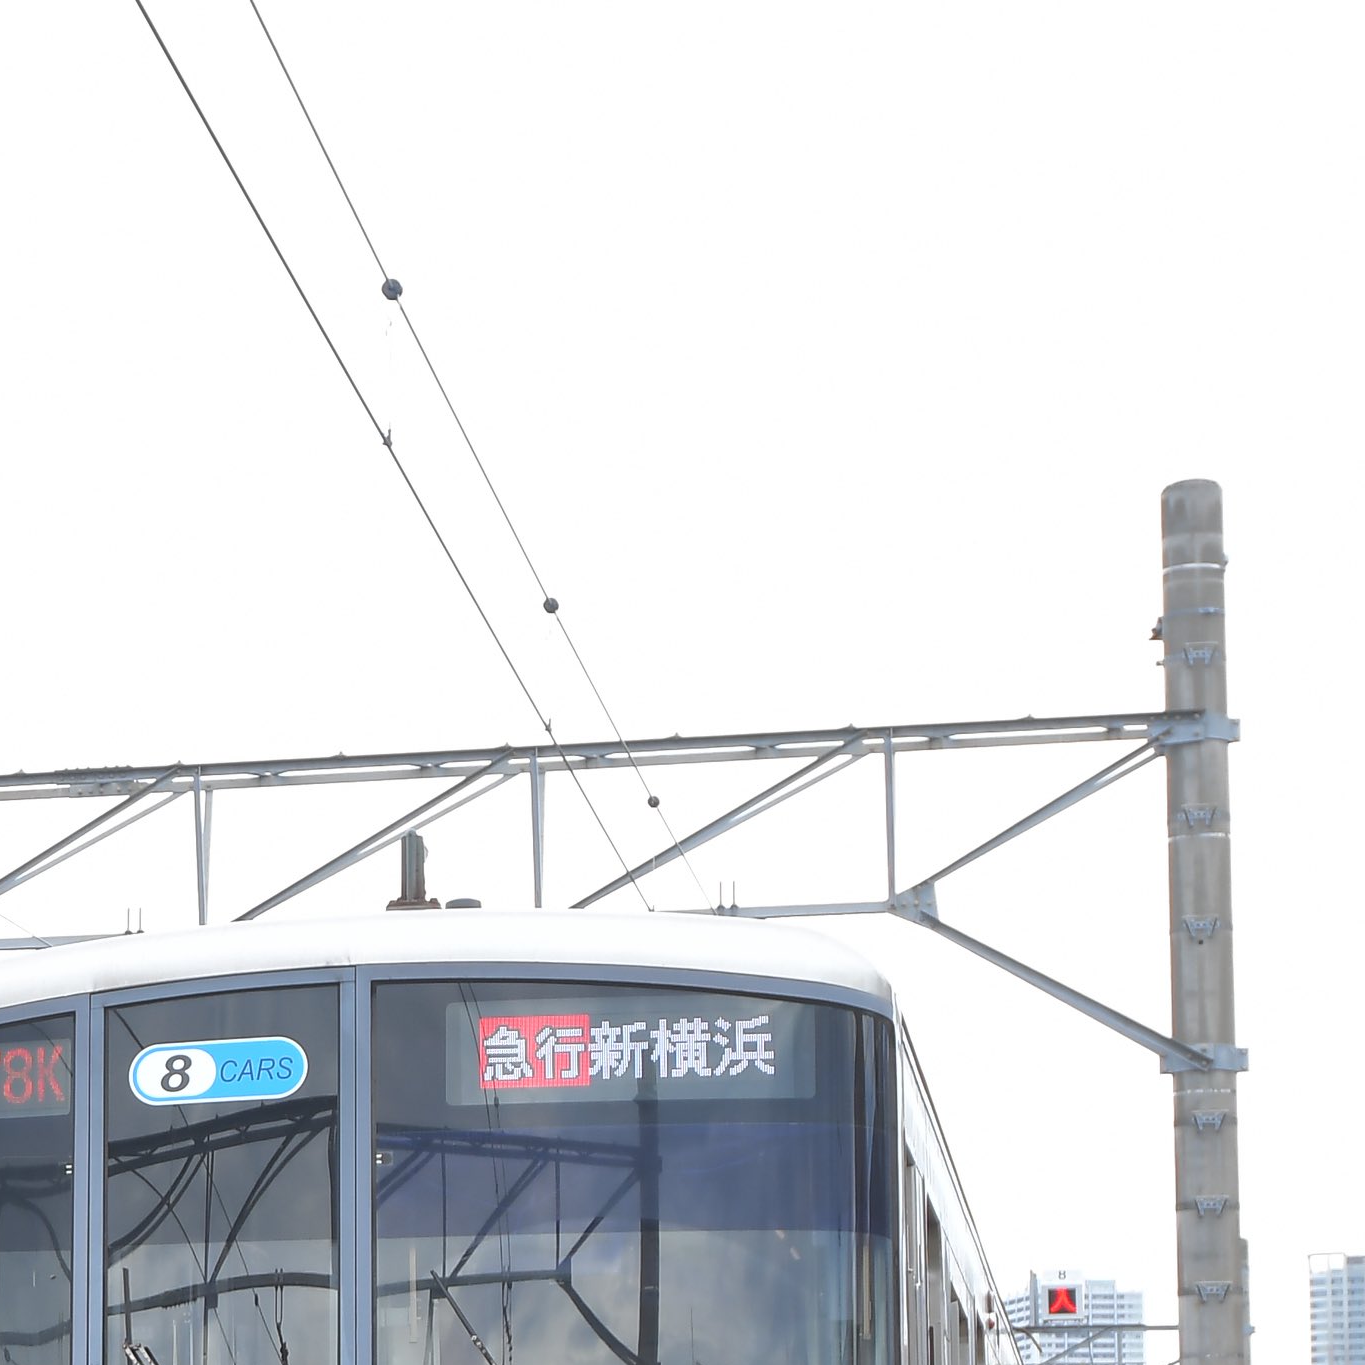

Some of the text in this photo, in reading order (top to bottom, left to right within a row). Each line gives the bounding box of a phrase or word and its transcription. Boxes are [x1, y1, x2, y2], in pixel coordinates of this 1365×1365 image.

[161, 1054, 293, 1093] 8 CARS
[483, 1015, 776, 1081] 急行 新横浜
